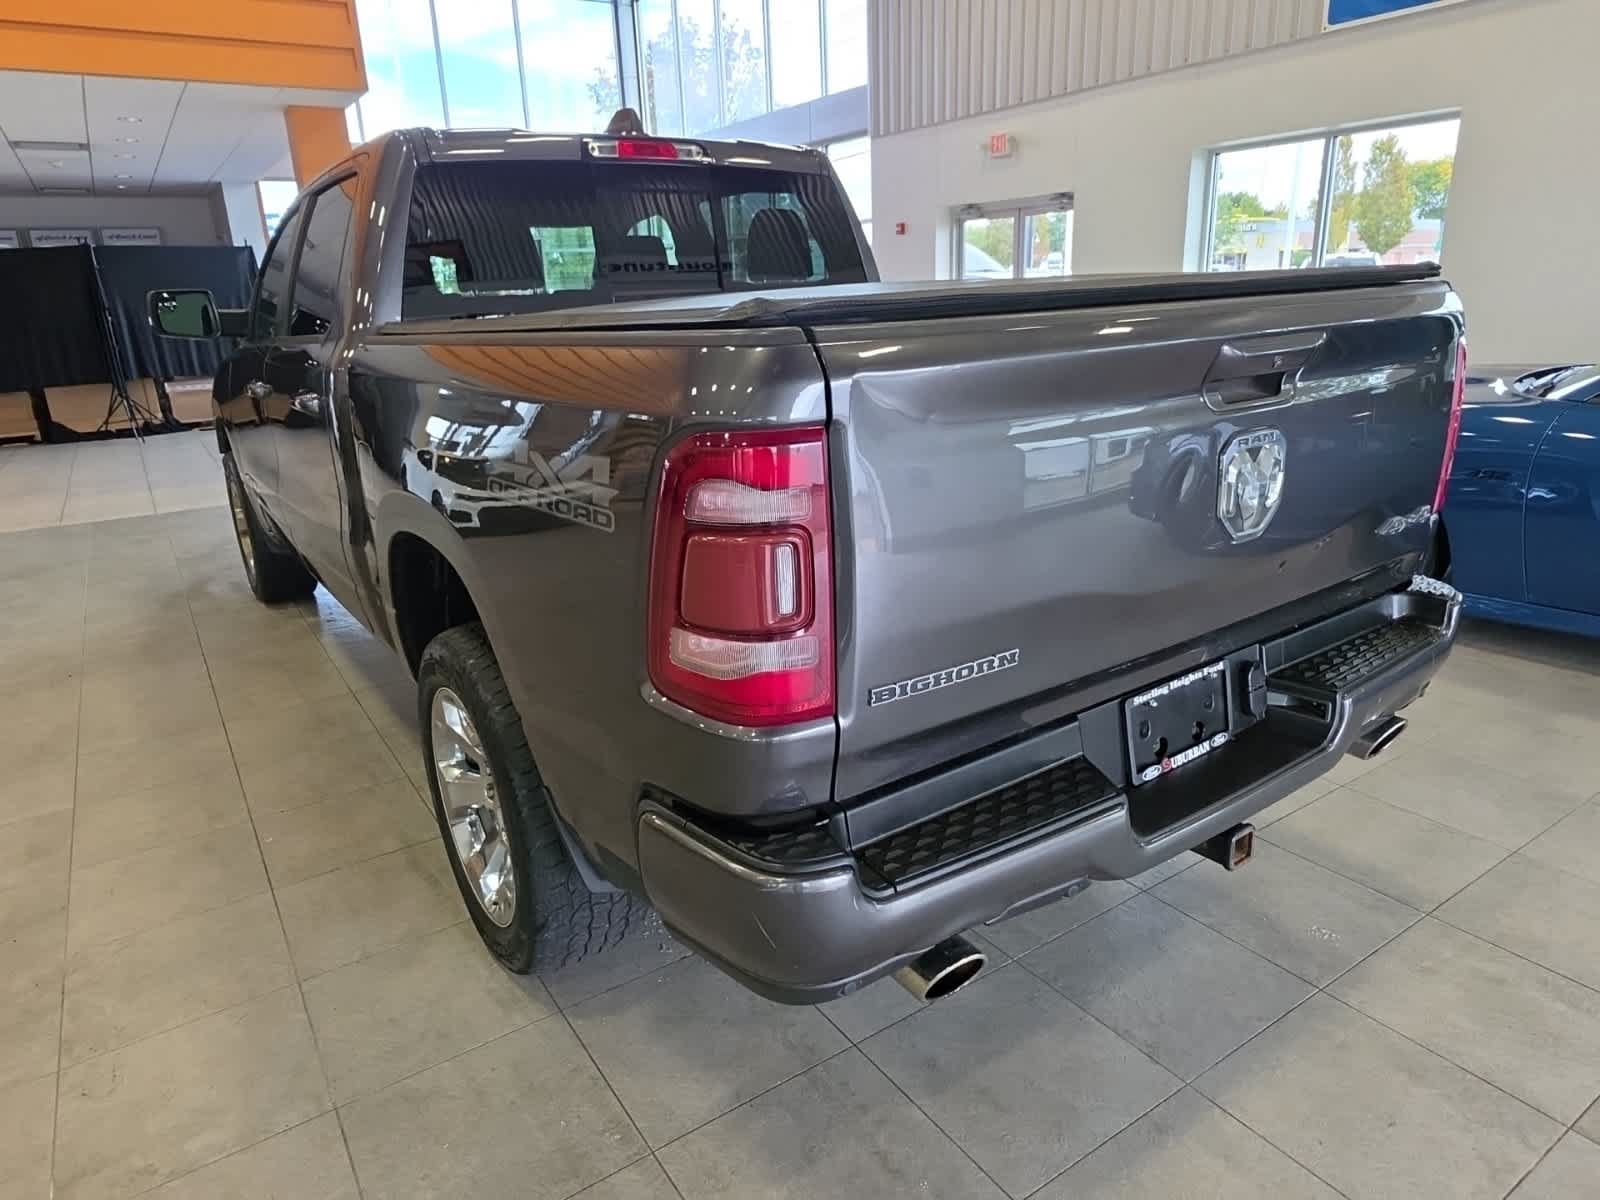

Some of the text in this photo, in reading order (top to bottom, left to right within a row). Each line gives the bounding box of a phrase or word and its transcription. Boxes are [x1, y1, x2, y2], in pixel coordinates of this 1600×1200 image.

[871, 649, 1019, 706] BIGHORN
[1203, 661, 1224, 676] Ford
[1161, 740, 1210, 773] SUBURBAN
